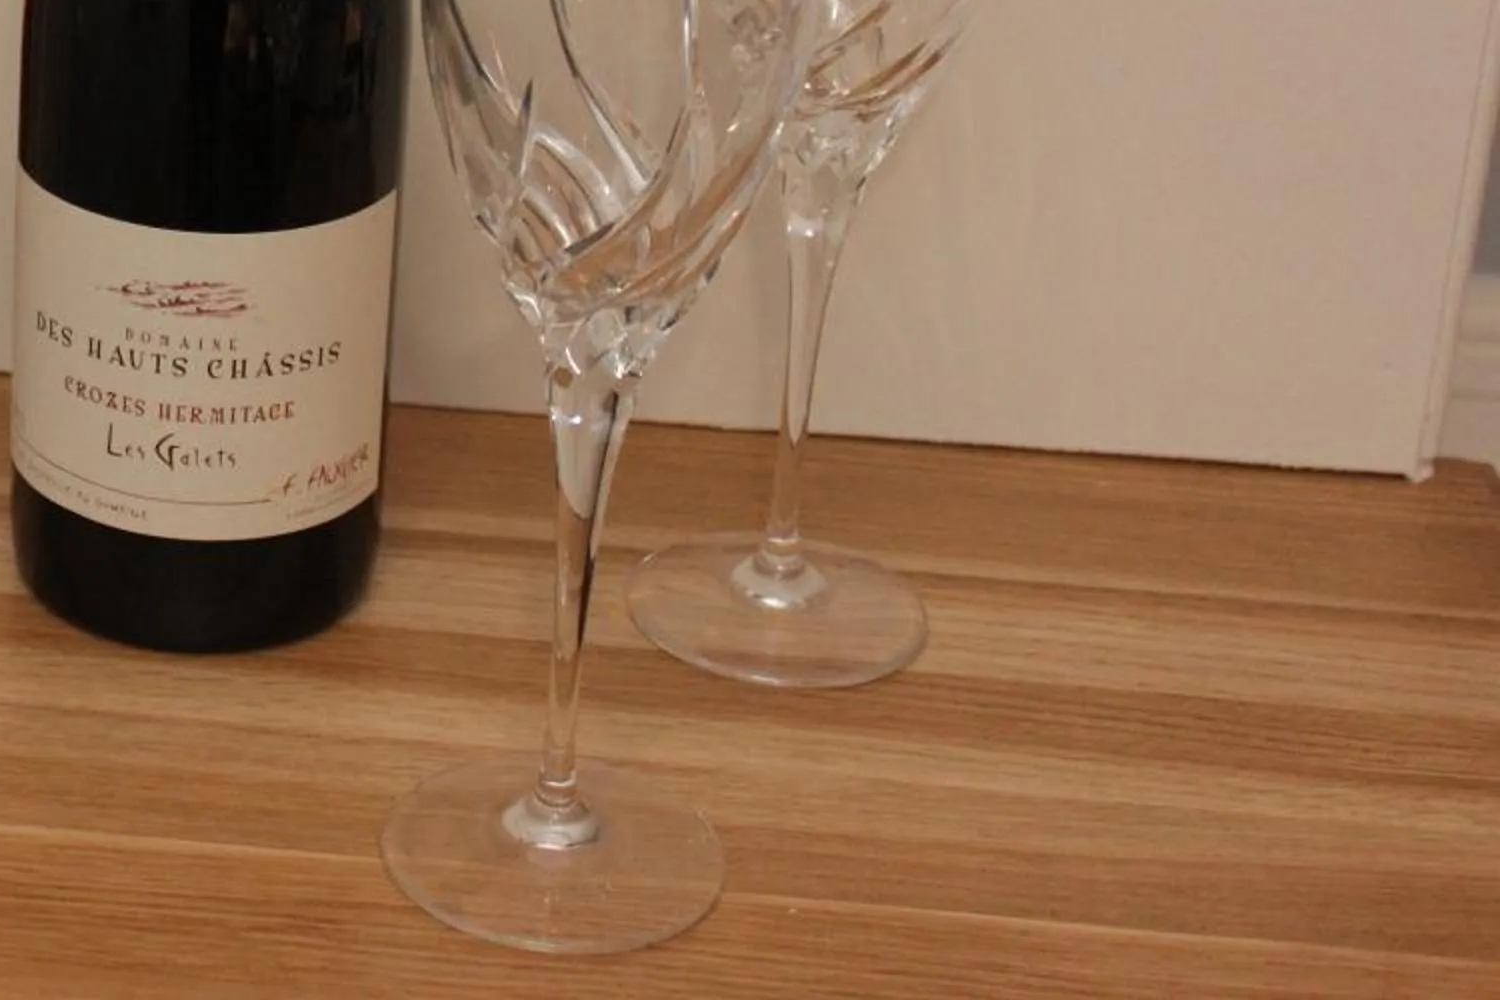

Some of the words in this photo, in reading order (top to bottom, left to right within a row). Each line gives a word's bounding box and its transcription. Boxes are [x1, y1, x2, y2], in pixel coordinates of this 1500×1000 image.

[35, 310, 74, 347] DES
[87, 335, 189, 377] HAUTS
[124, 327, 239, 352] DOMAINE
[64, 375, 146, 417] CROZES
[105, 421, 146, 461] Les
[154, 431, 237, 473] Galets
